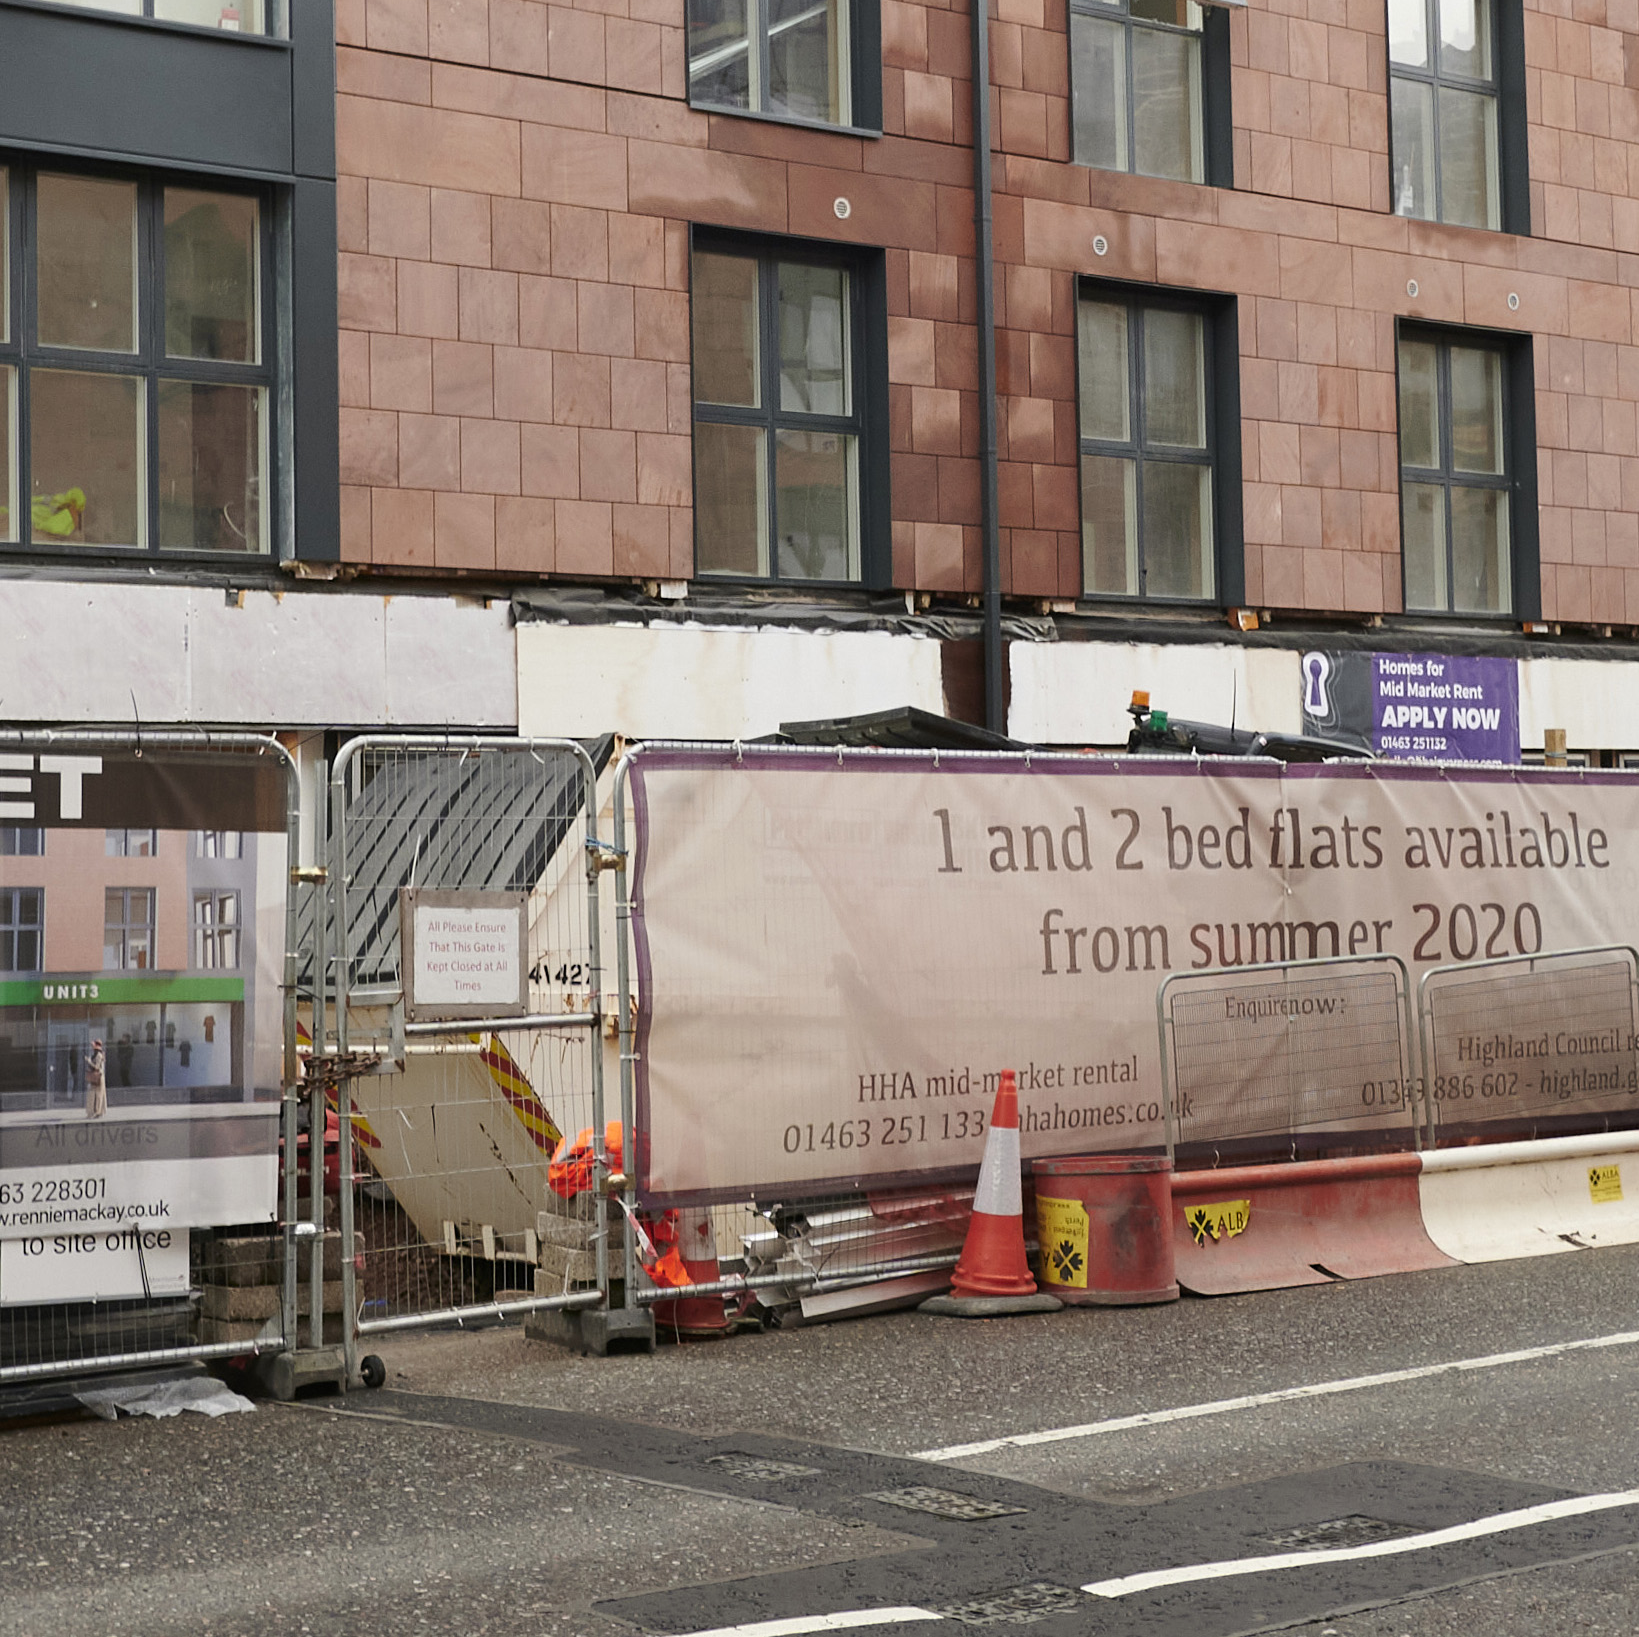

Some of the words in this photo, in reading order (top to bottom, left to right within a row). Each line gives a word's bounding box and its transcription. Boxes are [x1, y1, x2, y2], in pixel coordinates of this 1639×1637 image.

[1379, 659, 1423, 675] Homes
[1426, 660, 1444, 676] for
[1380, 681, 1404, 697] Mid
[1407, 682, 1451, 699] Market
[1453, 683, 1483, 700] Rent
[1381, 705, 1448, 729] APPLY
[1452, 707, 1501, 730] NOW
[1381, 735, 1410, 749] 01463
[1413, 736, 1447, 750] 251132
[933, 808, 963, 873] 1
[987, 806, 1093, 873] and
[1110, 808, 1144, 871] 2
[1161, 806, 1251, 870] bed
[1268, 807, 1384, 870] flats
[1404, 810, 1611, 870] available
[428, 921, 441, 933] All
[442, 921, 473, 933] Please
[475, 921, 507, 933] Ensure
[1039, 909, 1172, 975] from
[1189, 917, 1393, 970] summer
[1412, 902, 1543, 963] 2020
[429, 941, 450, 953] That
[452, 941, 472, 953] This
[473, 941, 496, 953] Gate
[498, 941, 506, 953] Is
[426, 961, 449, 973] Kept
[451, 961, 482, 973] Closed
[484, 962, 494, 973] at
[496, 961, 508, 972] All
[454, 980, 482, 992] Times
[1225, 996, 1289, 1024] Enquire
[1457, 1032, 1549, 1065] Highland
[1555, 1026, 1621, 1056] Council
[857, 1070, 918, 1103] HHA
[925, 1061, 1065, 1100] mid-mrket
[1072, 1054, 1139, 1086] rental
[1433, 1074, 1475, 1102] 886
[1481, 1071, 1519, 1098] 602
[74, 1121, 160, 1148] drivers
[782, 1117, 871, 1154] 01463
[880, 1114, 927, 1146] 251
[940, 1109, 985, 1140] 133
[31, 1178, 107, 1204] 228301
[21, 1234, 46, 1257] to
[53, 1234, 97, 1255] site
